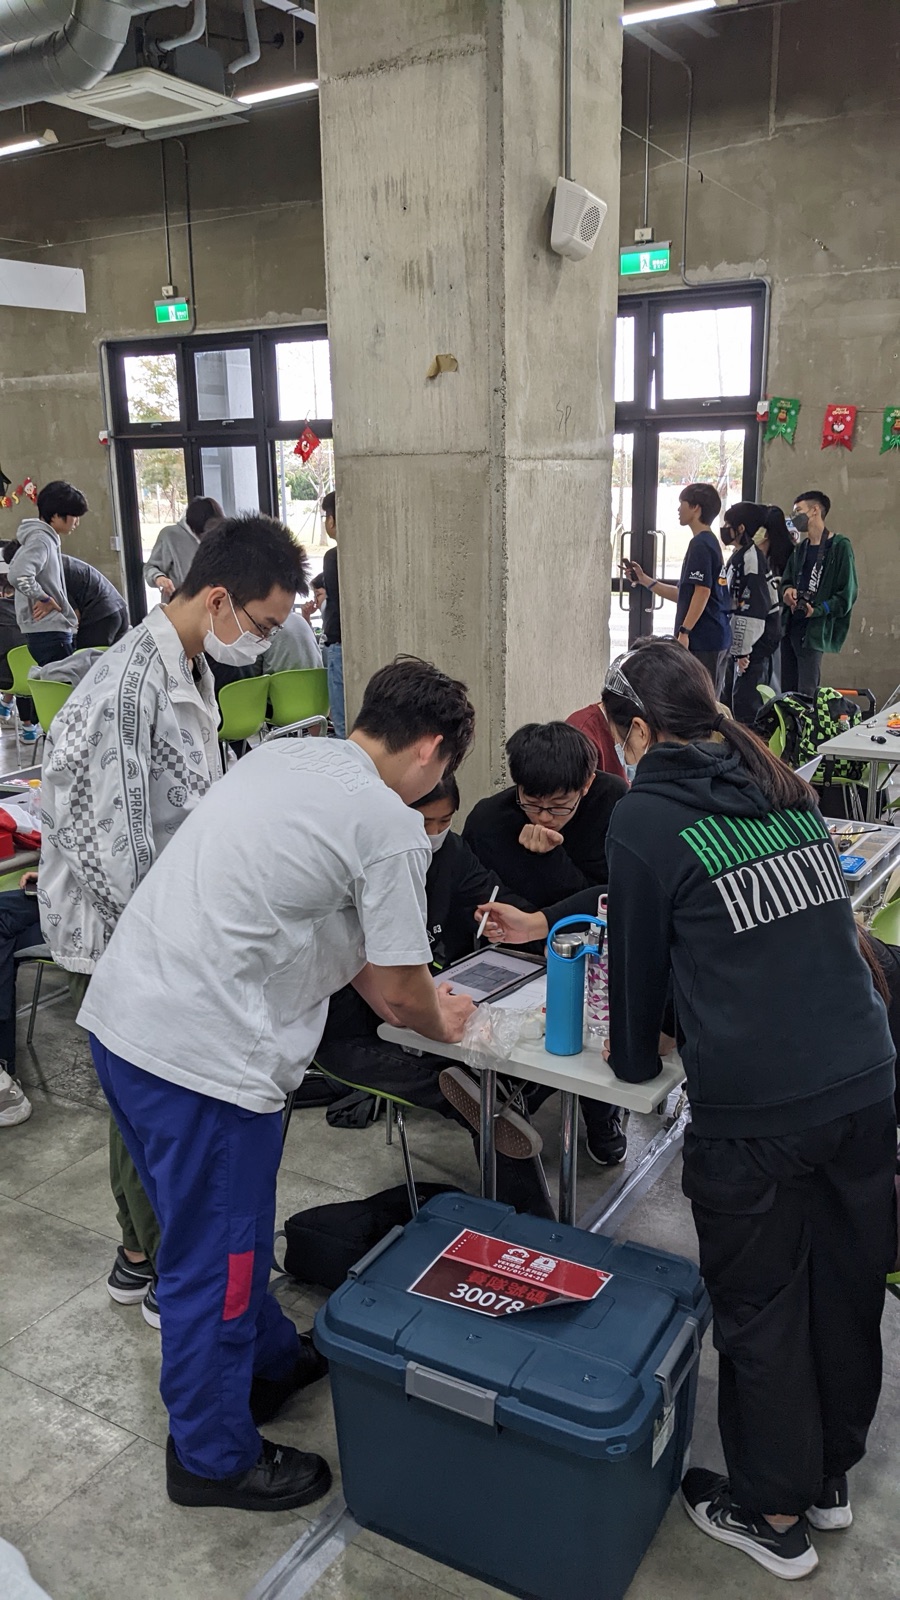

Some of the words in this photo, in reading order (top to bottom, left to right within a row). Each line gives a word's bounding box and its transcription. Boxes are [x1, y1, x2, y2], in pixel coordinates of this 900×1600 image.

[121, 670, 141, 746] SPRAYGROUND
[128, 787, 149, 863] SPRAYGROUND
[678, 808, 829, 878] BILINGUAL
